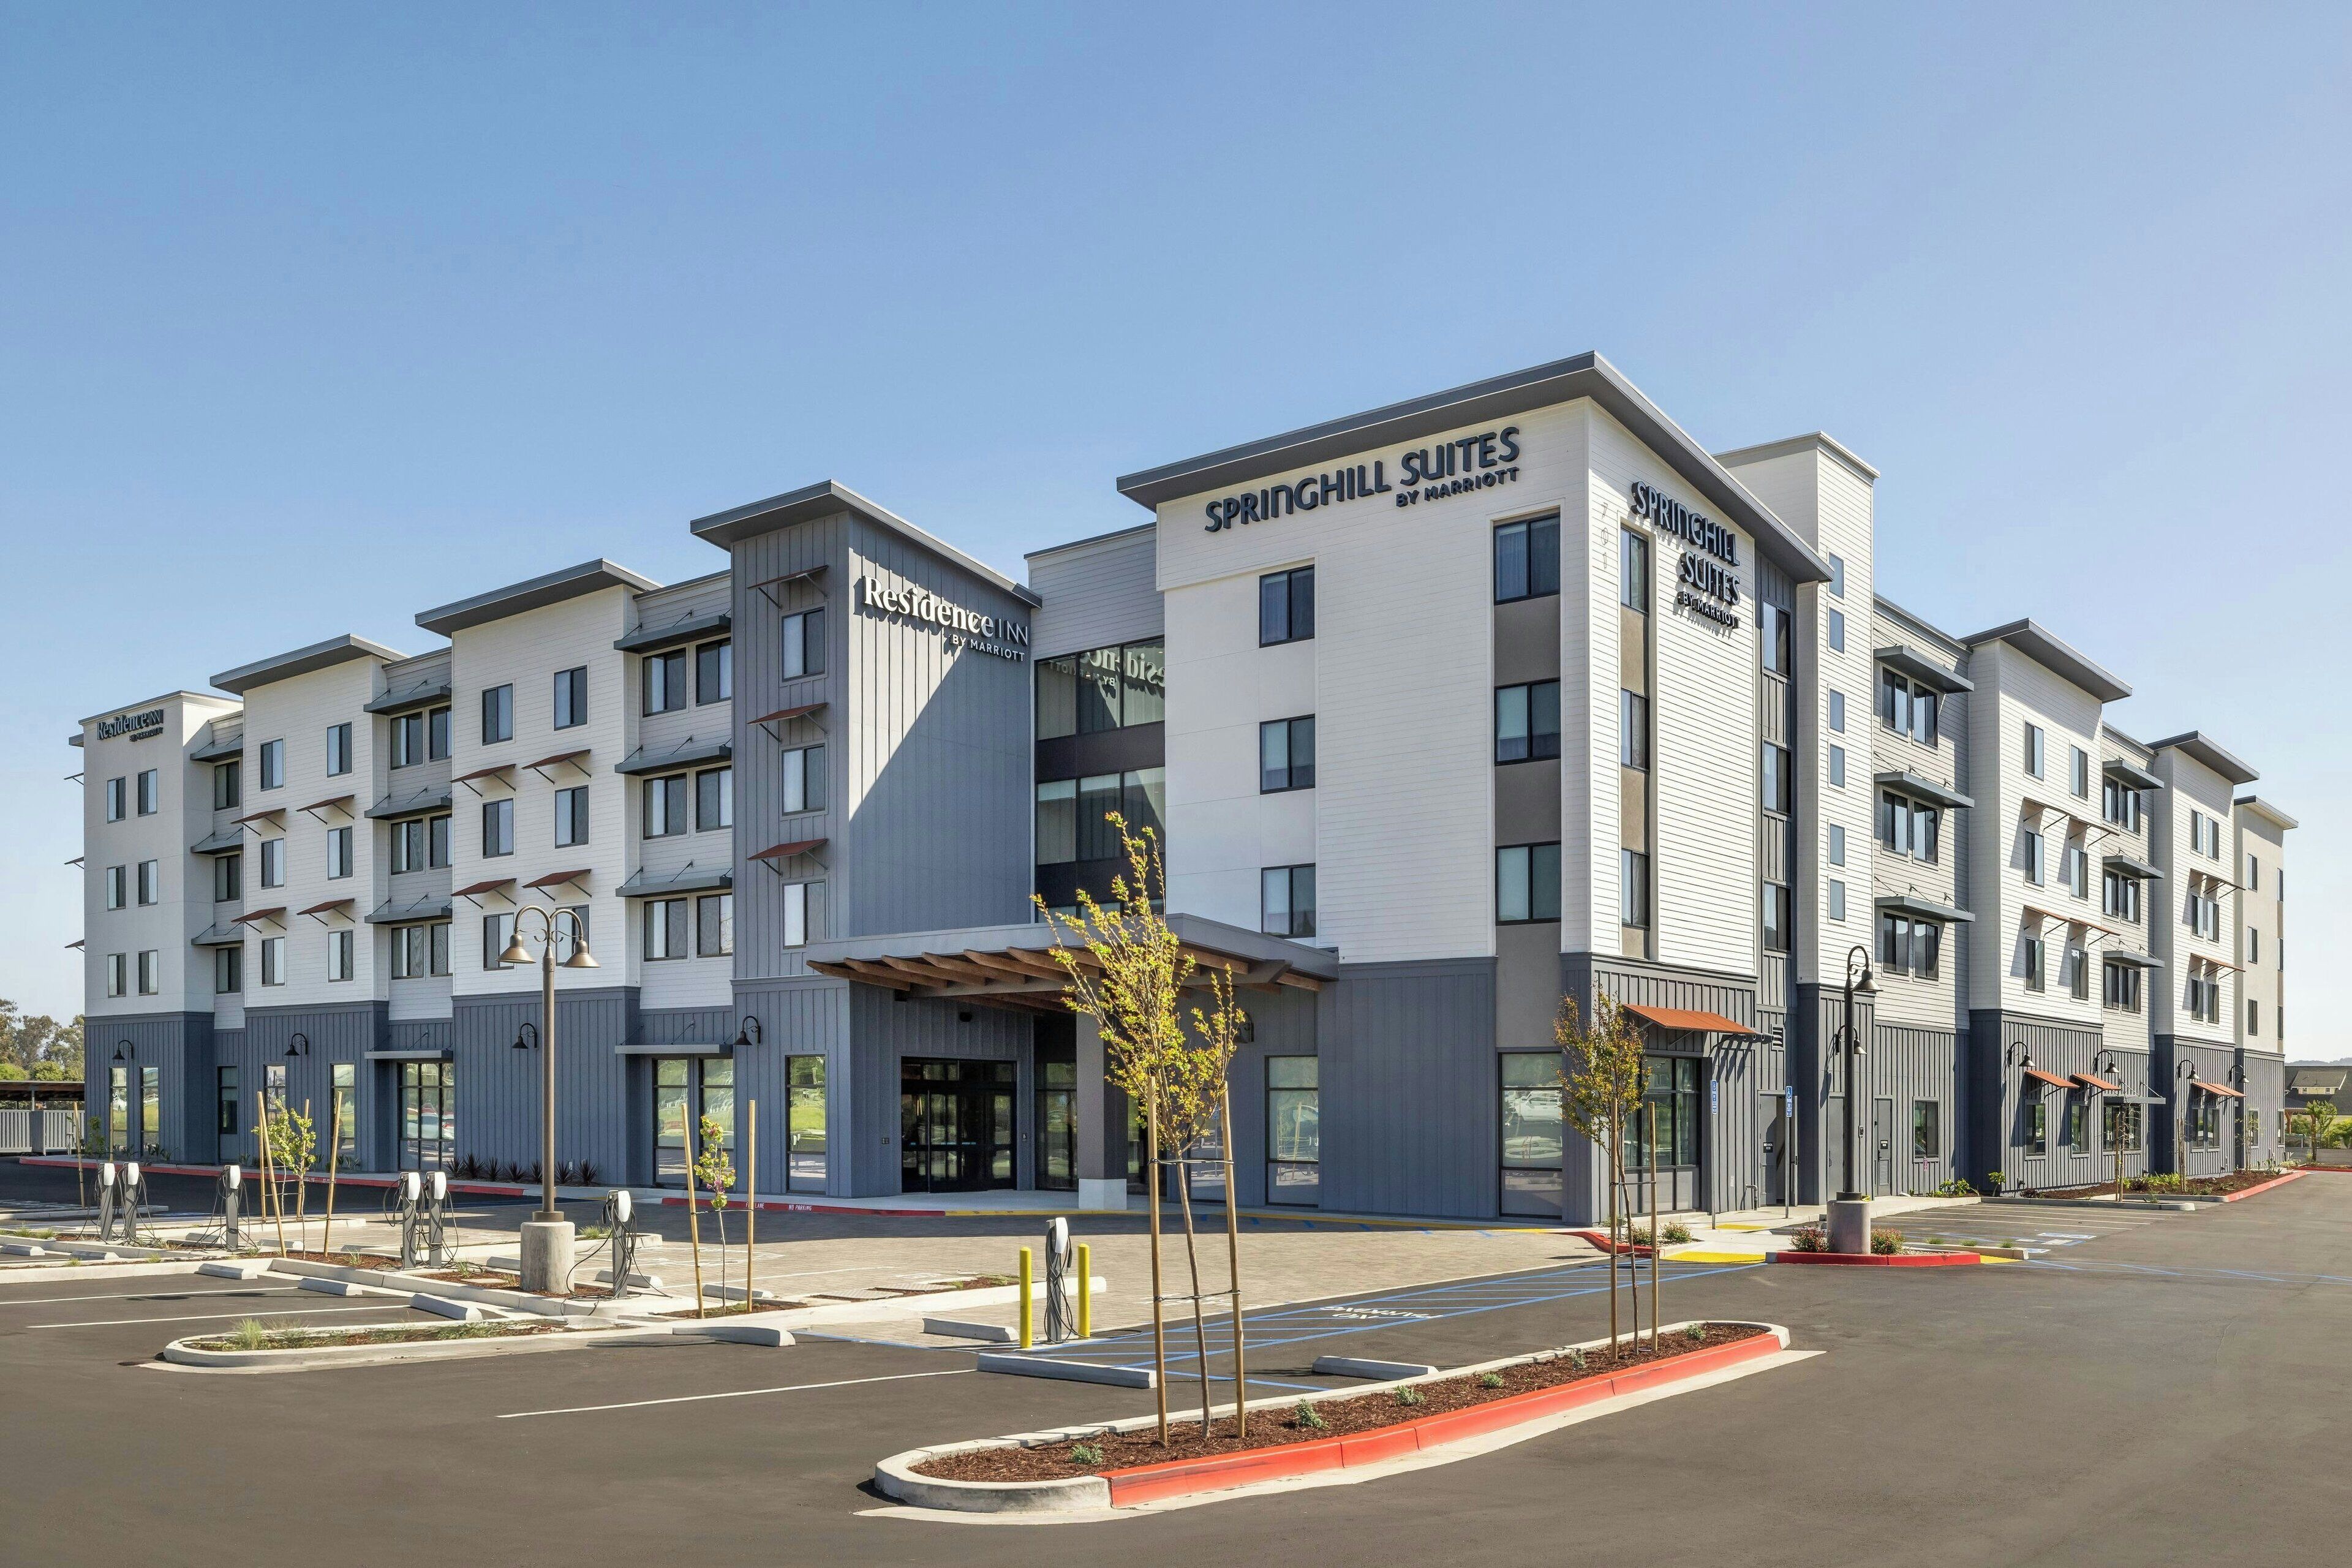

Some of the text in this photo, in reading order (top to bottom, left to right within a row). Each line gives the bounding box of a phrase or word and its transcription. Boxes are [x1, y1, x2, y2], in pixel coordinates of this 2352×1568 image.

[1204, 426, 1520, 533] SPRINGHILL SUITES
[1396, 466, 1520, 508] BY MARRIOTT
[1600, 502, 1609, 570] 701
[1631, 481, 1740, 567] SPRINGHILL
[1680, 551, 1741, 606] SUITES
[862, 575, 1028, 646] Residence INN
[1678, 592, 1740, 629] BY MARRIOTT
[951, 634, 1025, 662] BY MARRIOTT
[97, 713, 147, 740] Residence
